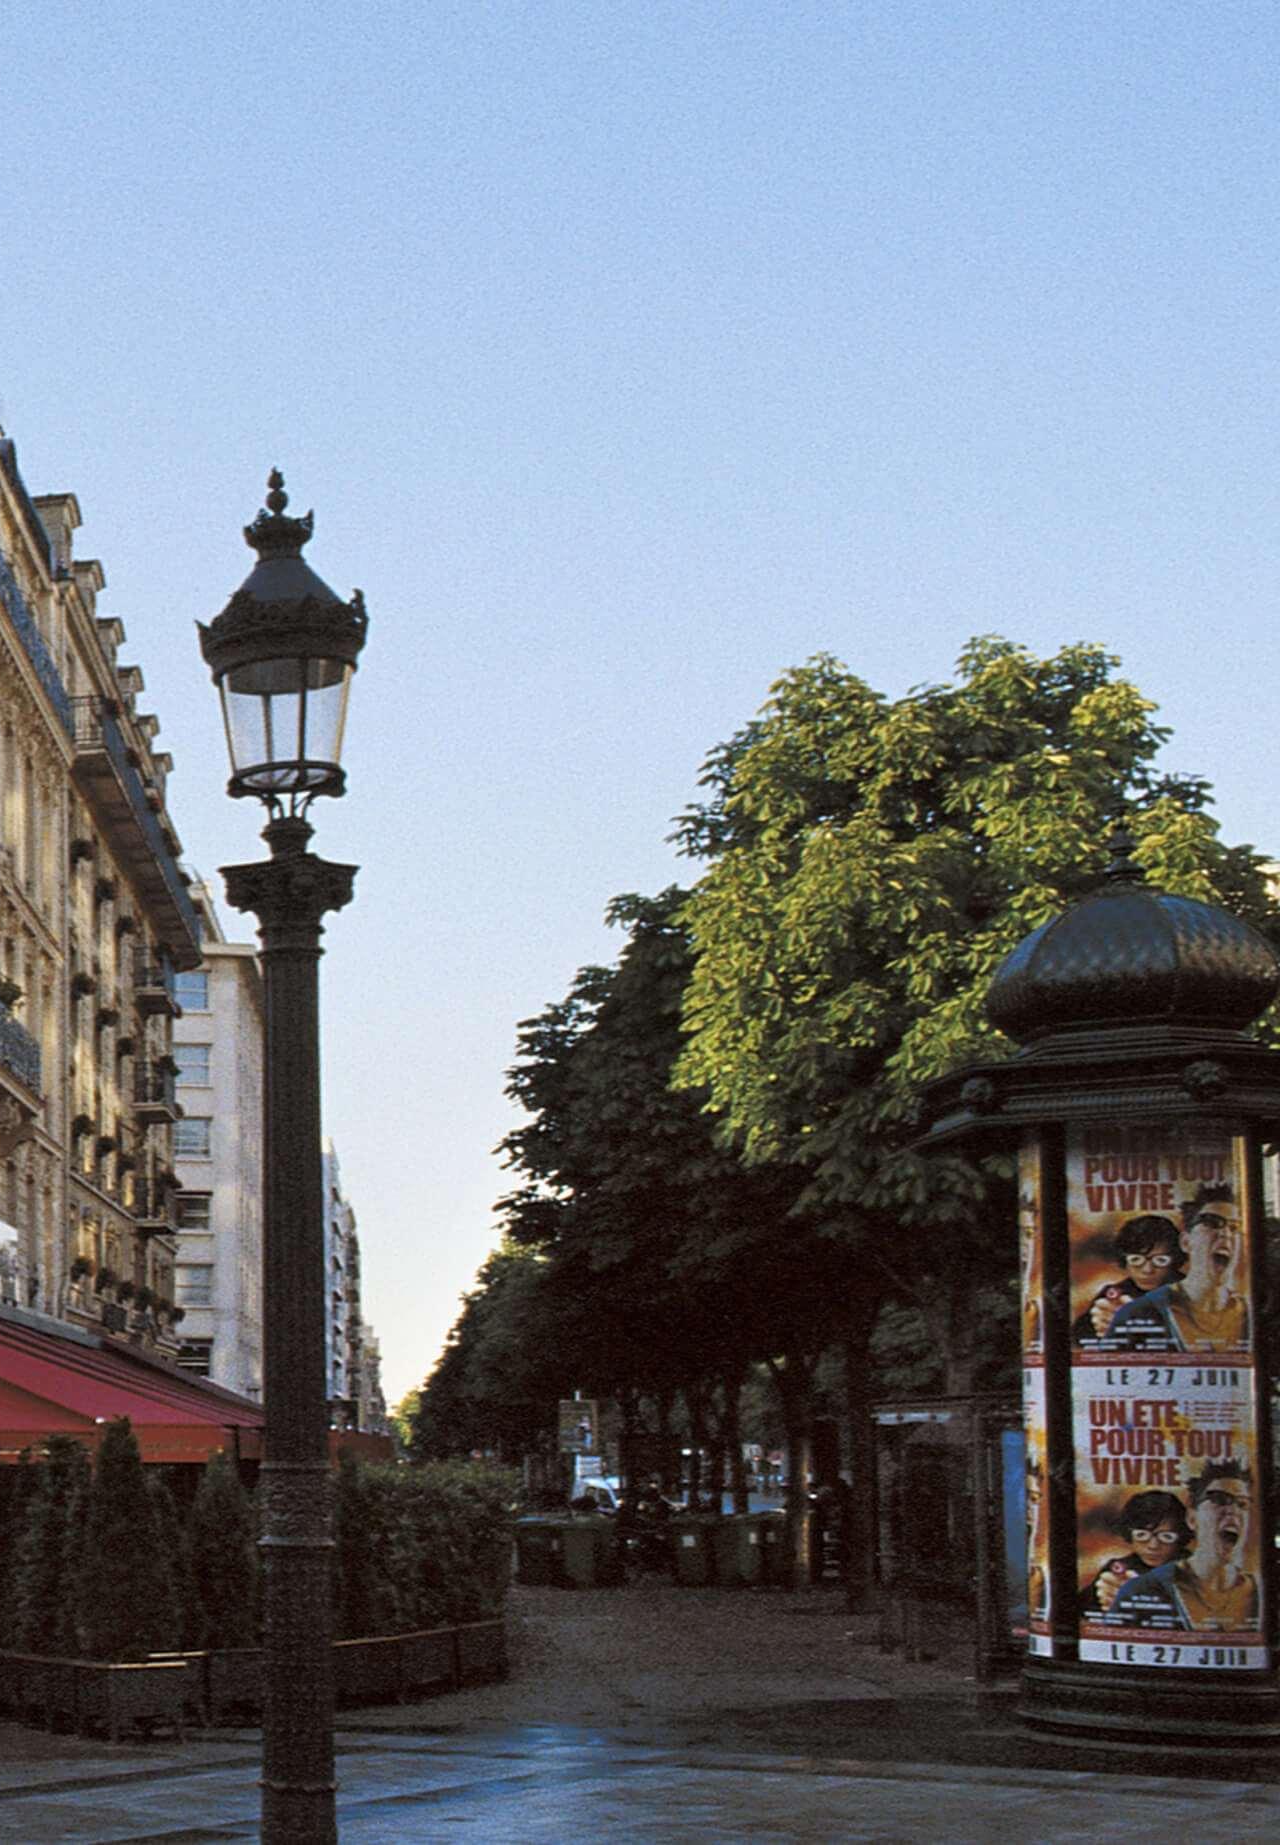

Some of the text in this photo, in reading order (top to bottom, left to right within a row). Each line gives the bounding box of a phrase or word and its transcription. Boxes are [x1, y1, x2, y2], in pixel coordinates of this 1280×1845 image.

[1085, 1153, 1226, 1183] POUR TOUT
[1085, 1184, 1175, 1212] VIVRE
[1106, 1368, 1240, 1387] LE 27 JUIN
[1089, 1399, 1122, 1427] UN
[1090, 1428, 1234, 1458] POUR TOUT
[1090, 1458, 1183, 1487] VIVRE
[1111, 1644, 1249, 1666] LE 27 JUIN
